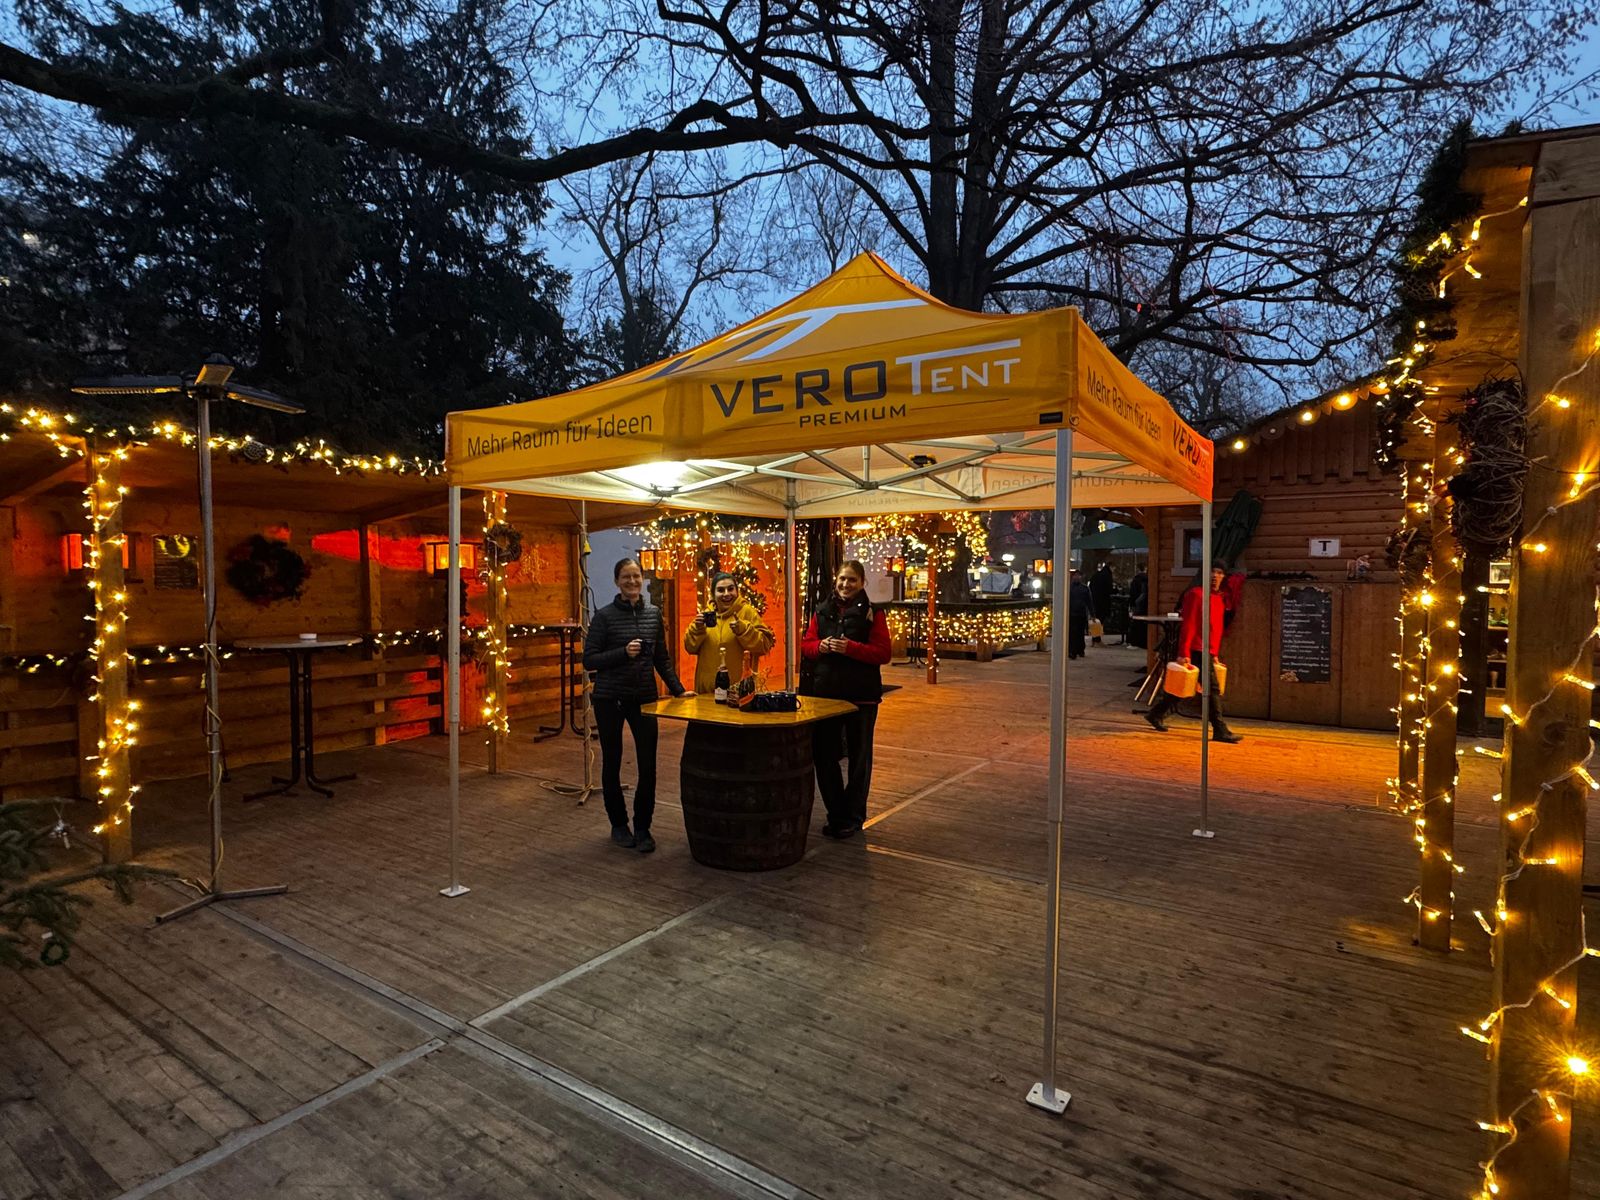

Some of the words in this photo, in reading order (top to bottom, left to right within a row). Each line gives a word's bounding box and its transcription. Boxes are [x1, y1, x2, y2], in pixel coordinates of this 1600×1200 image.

[799, 403, 906, 428] PREMIUM
[1086, 366, 1110, 407] Mehr
[1113, 387, 1134, 422] Raum
[1145, 410, 1161, 441] Ideen
[467, 434, 507, 457] Mehr
[512, 426, 560, 451] Raum
[565, 419, 592, 444] für
[597, 412, 652, 439] Ideen
[1318, 540, 1332, 552] T
